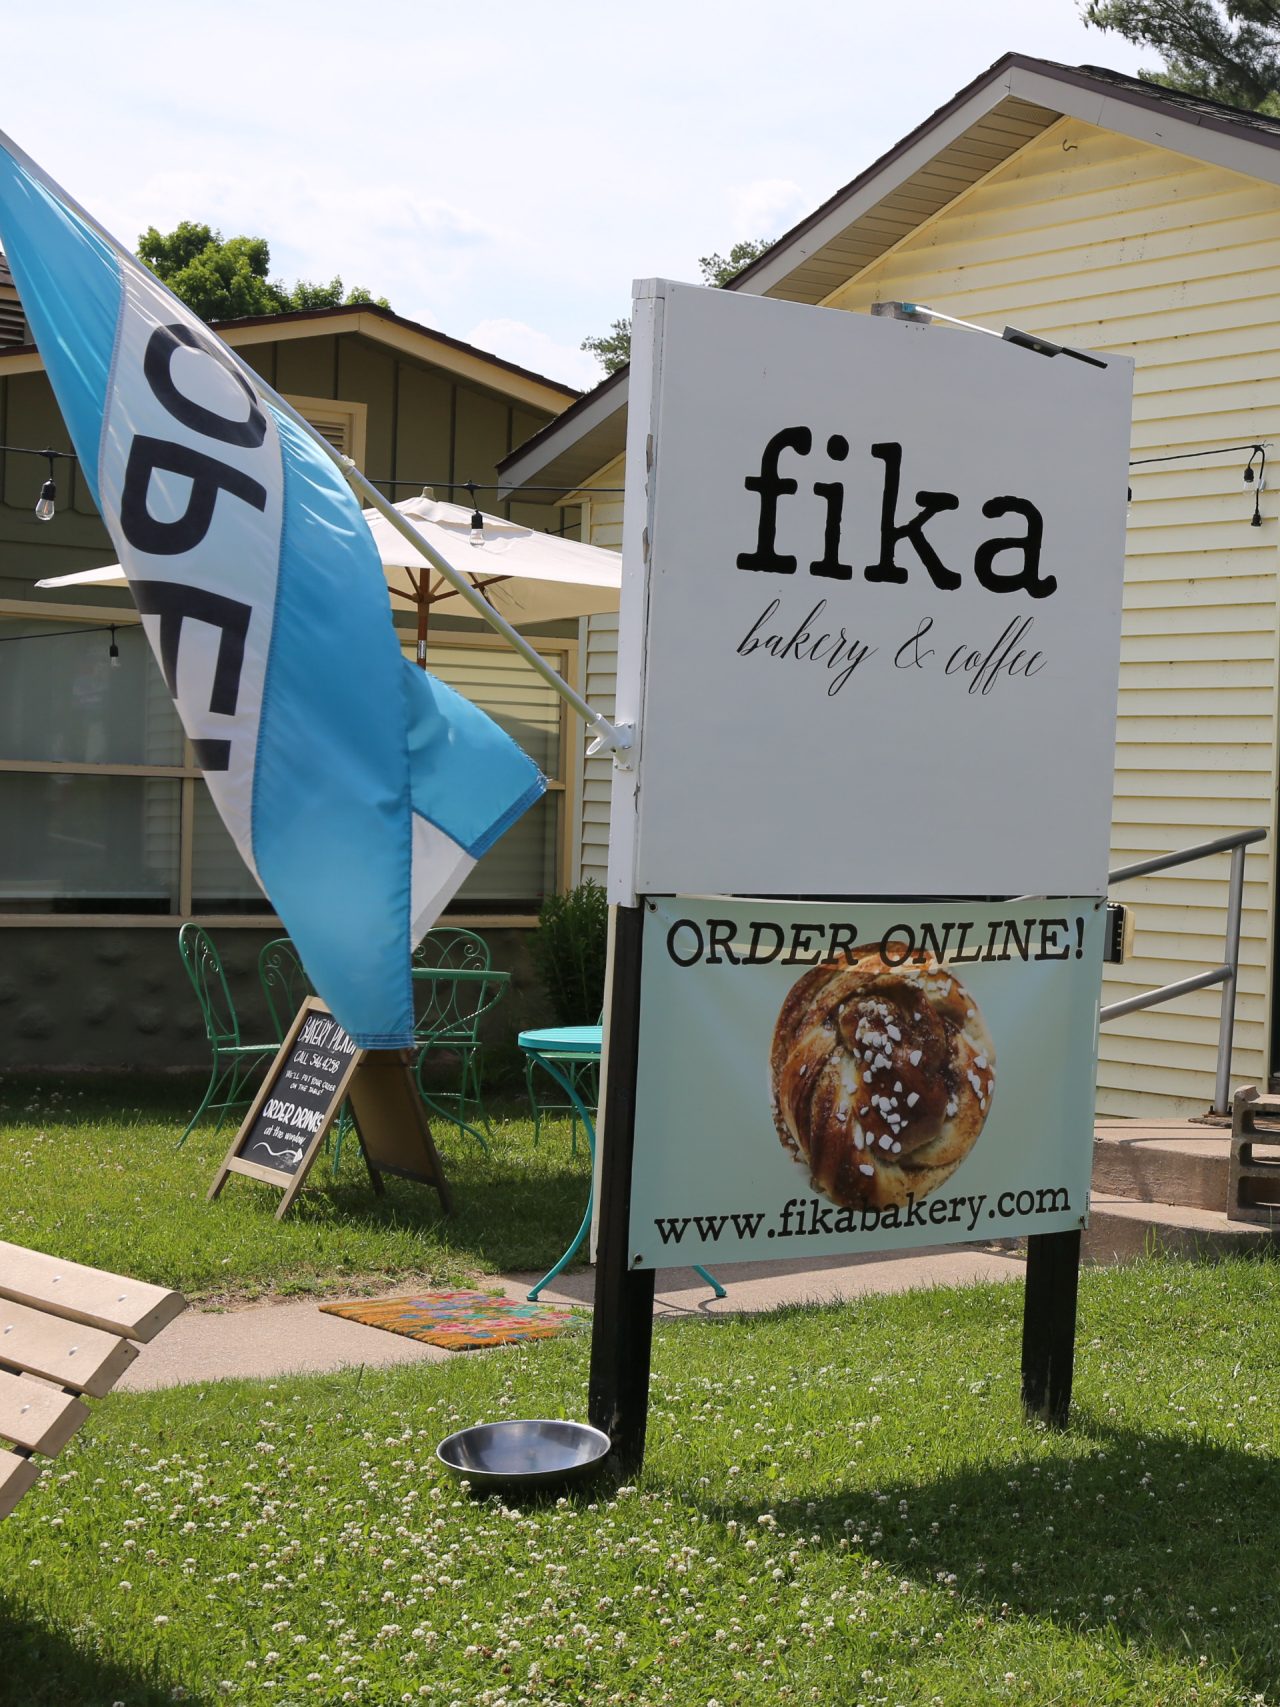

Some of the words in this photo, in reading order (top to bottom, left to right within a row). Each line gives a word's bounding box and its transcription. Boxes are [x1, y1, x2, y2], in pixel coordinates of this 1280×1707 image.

[736, 426, 1057, 599] fika
[736, 599, 879, 697] bakery
[894, 616, 935, 669] &
[945, 615, 1047, 696] coffee
[667, 918, 859, 967] ORDER
[878, 917, 1086, 967] ONLINE!
[297, 1016, 337, 1048] BAKERY
[294, 1050, 309, 1065] CALL
[298, 1084, 309, 1092] THE
[262, 1098, 295, 1124] ORDER
[290, 1105, 325, 1133] DRINKS
[263, 1124, 274, 1136] at
[272, 1126, 284, 1139] the
[654, 1187, 1072, 1245] www.fikabakery.com
